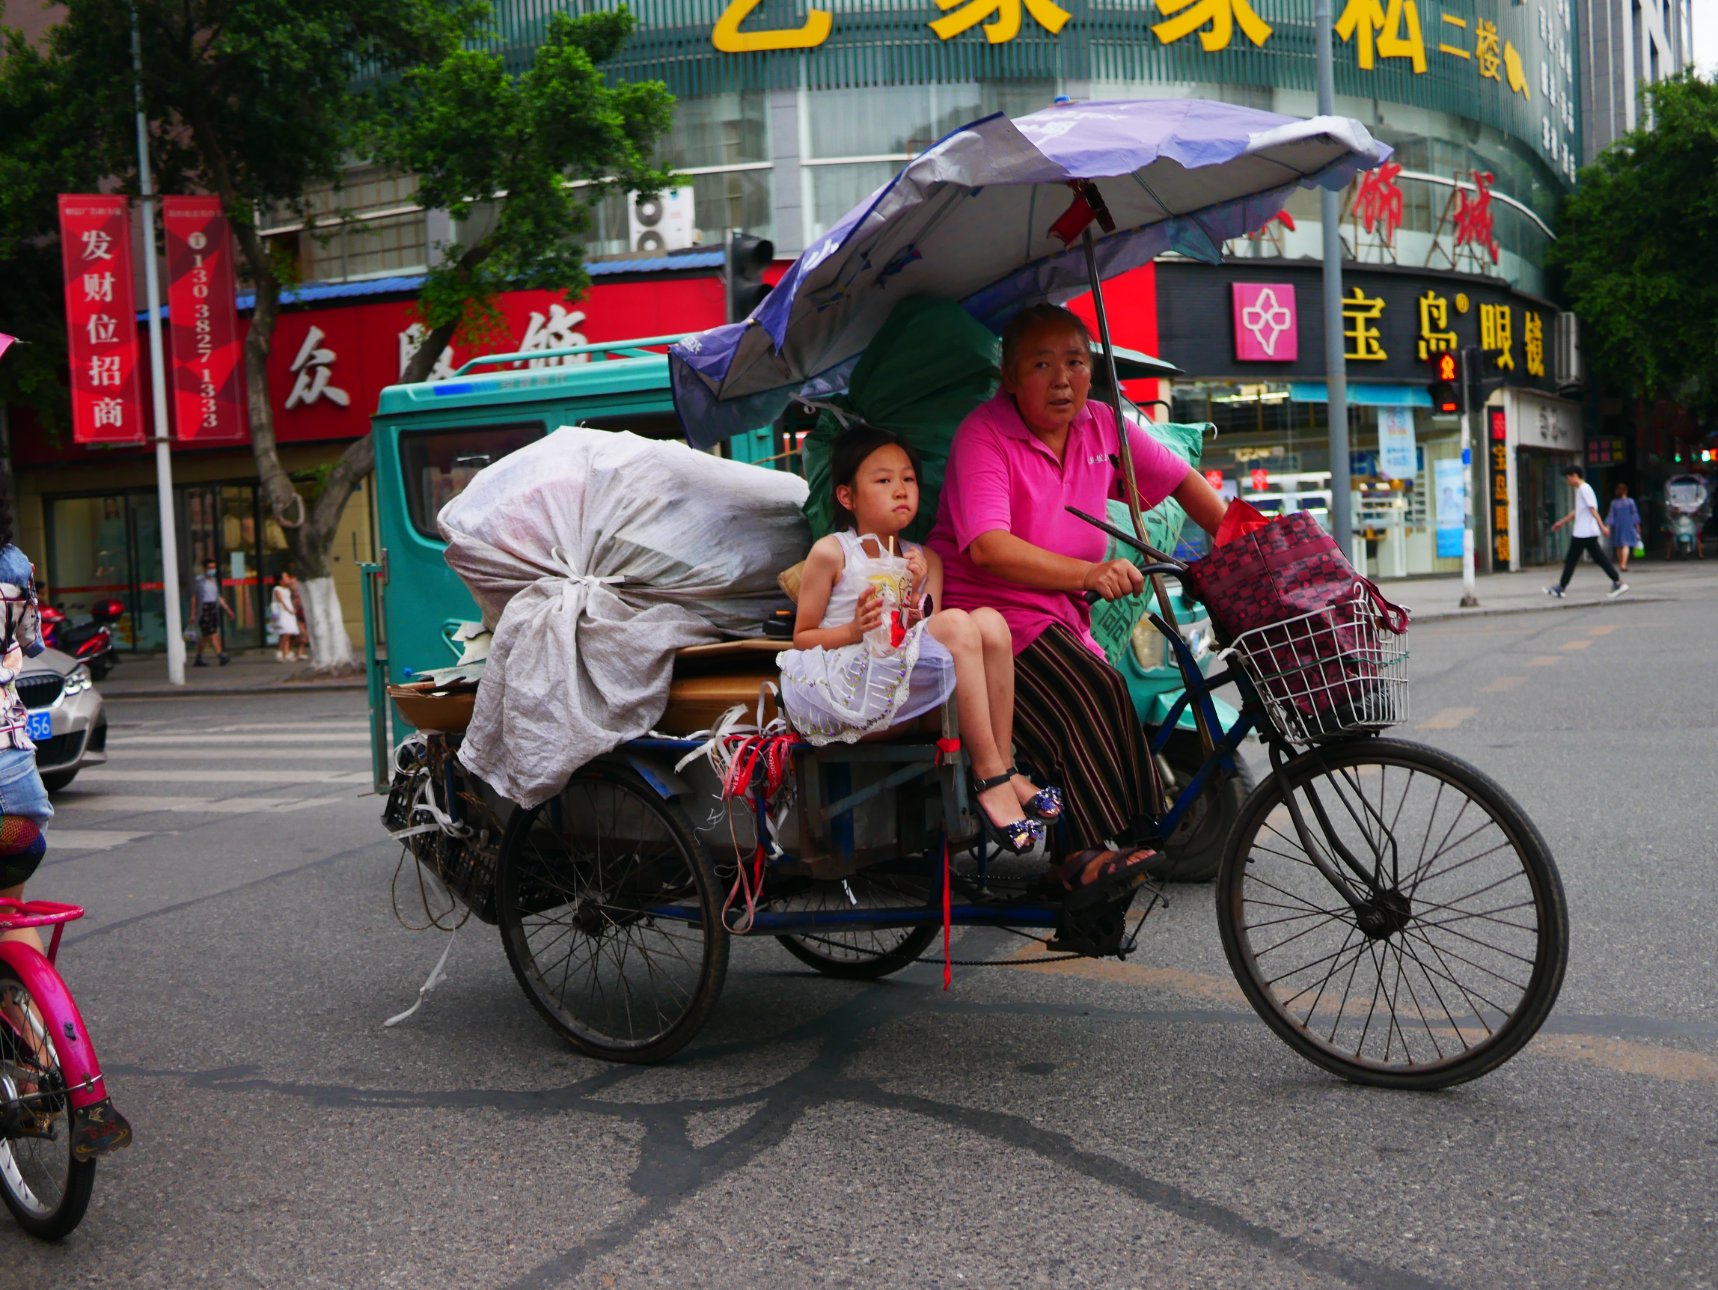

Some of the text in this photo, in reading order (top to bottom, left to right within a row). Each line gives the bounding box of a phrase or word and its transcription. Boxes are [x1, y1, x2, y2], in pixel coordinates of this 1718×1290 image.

[1439, 13, 1501, 82] 二楼
[81, 229, 124, 429] 发财位招商
[192, 254, 218, 428] 130 3827 1333
